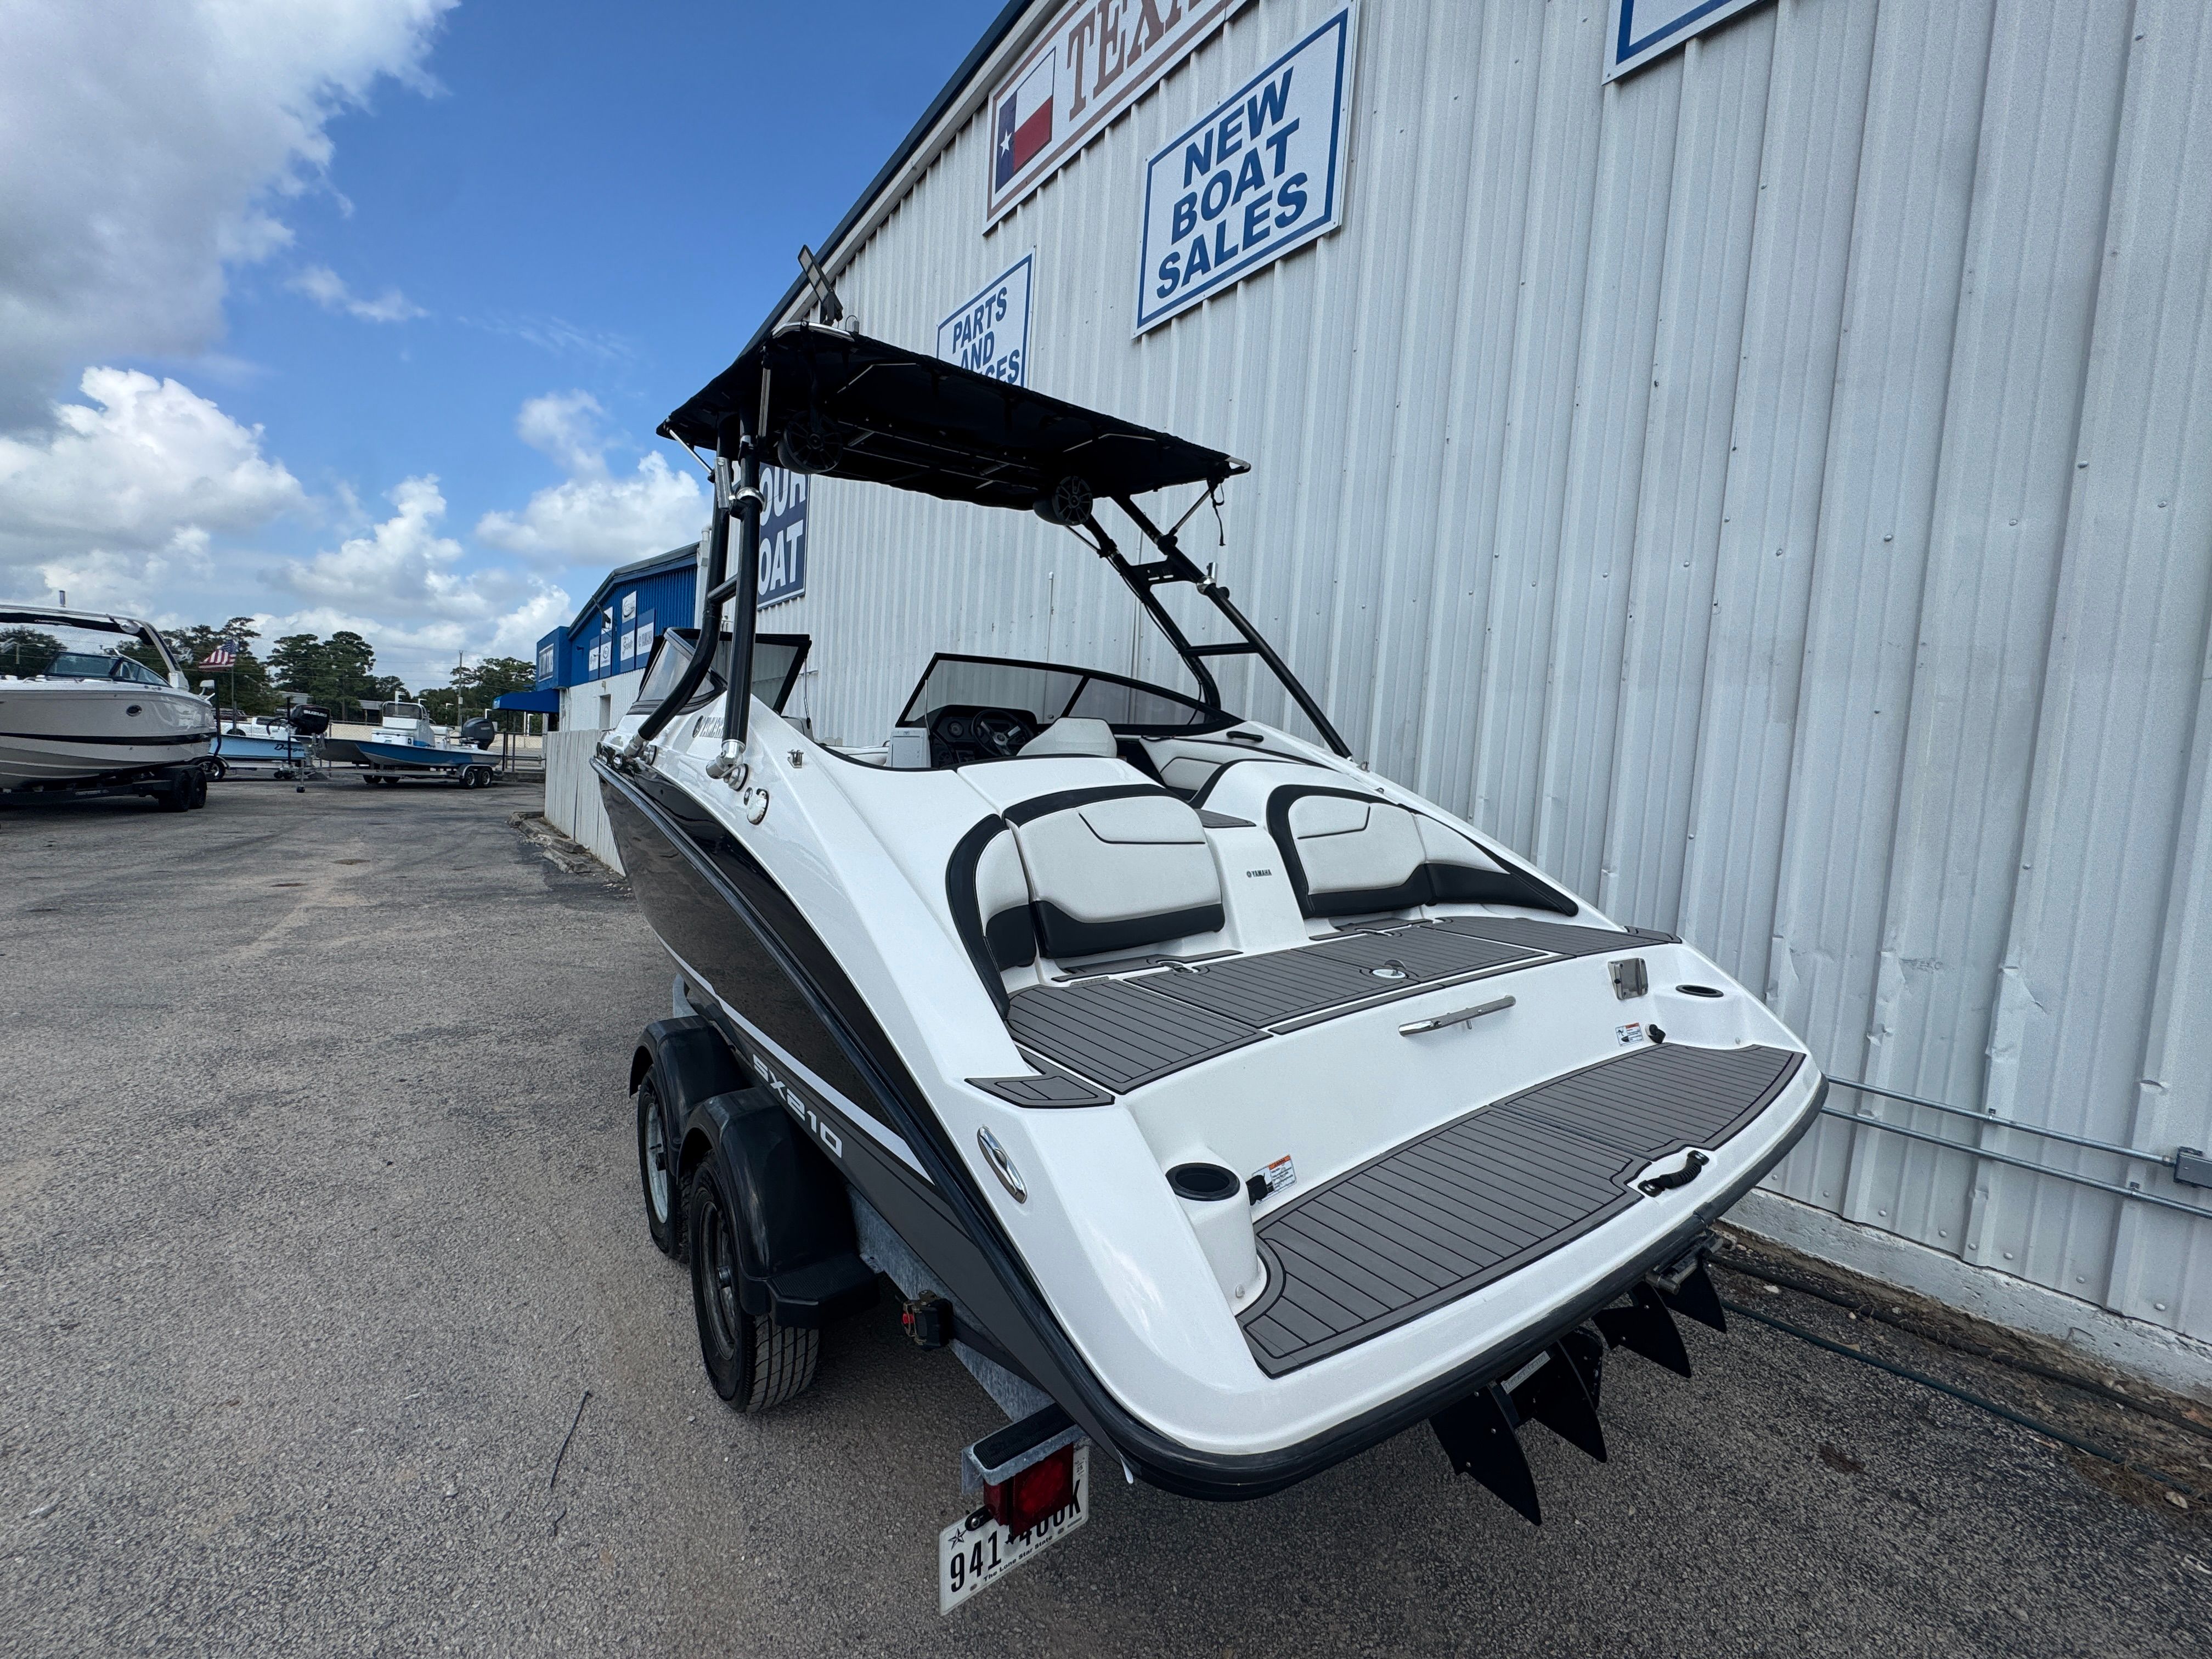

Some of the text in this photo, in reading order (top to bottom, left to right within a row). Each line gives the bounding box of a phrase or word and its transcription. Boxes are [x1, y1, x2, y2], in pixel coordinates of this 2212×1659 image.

[1067, 0, 1201, 122] TEX
[1183, 66, 1294, 189] NEW
[1171, 117, 1300, 245] BOAT
[1156, 172, 1308, 298] SALES
[952, 287, 1007, 354] PARTS
[961, 331, 995, 370] AND
[759, 467, 806, 526] OUR
[758, 520, 803, 596] OAT
[1251, 869, 1272, 877] YAMAHA
[753, 1054, 843, 1159] SX210
[984, 1536, 1053, 1582] The Lone Star State
